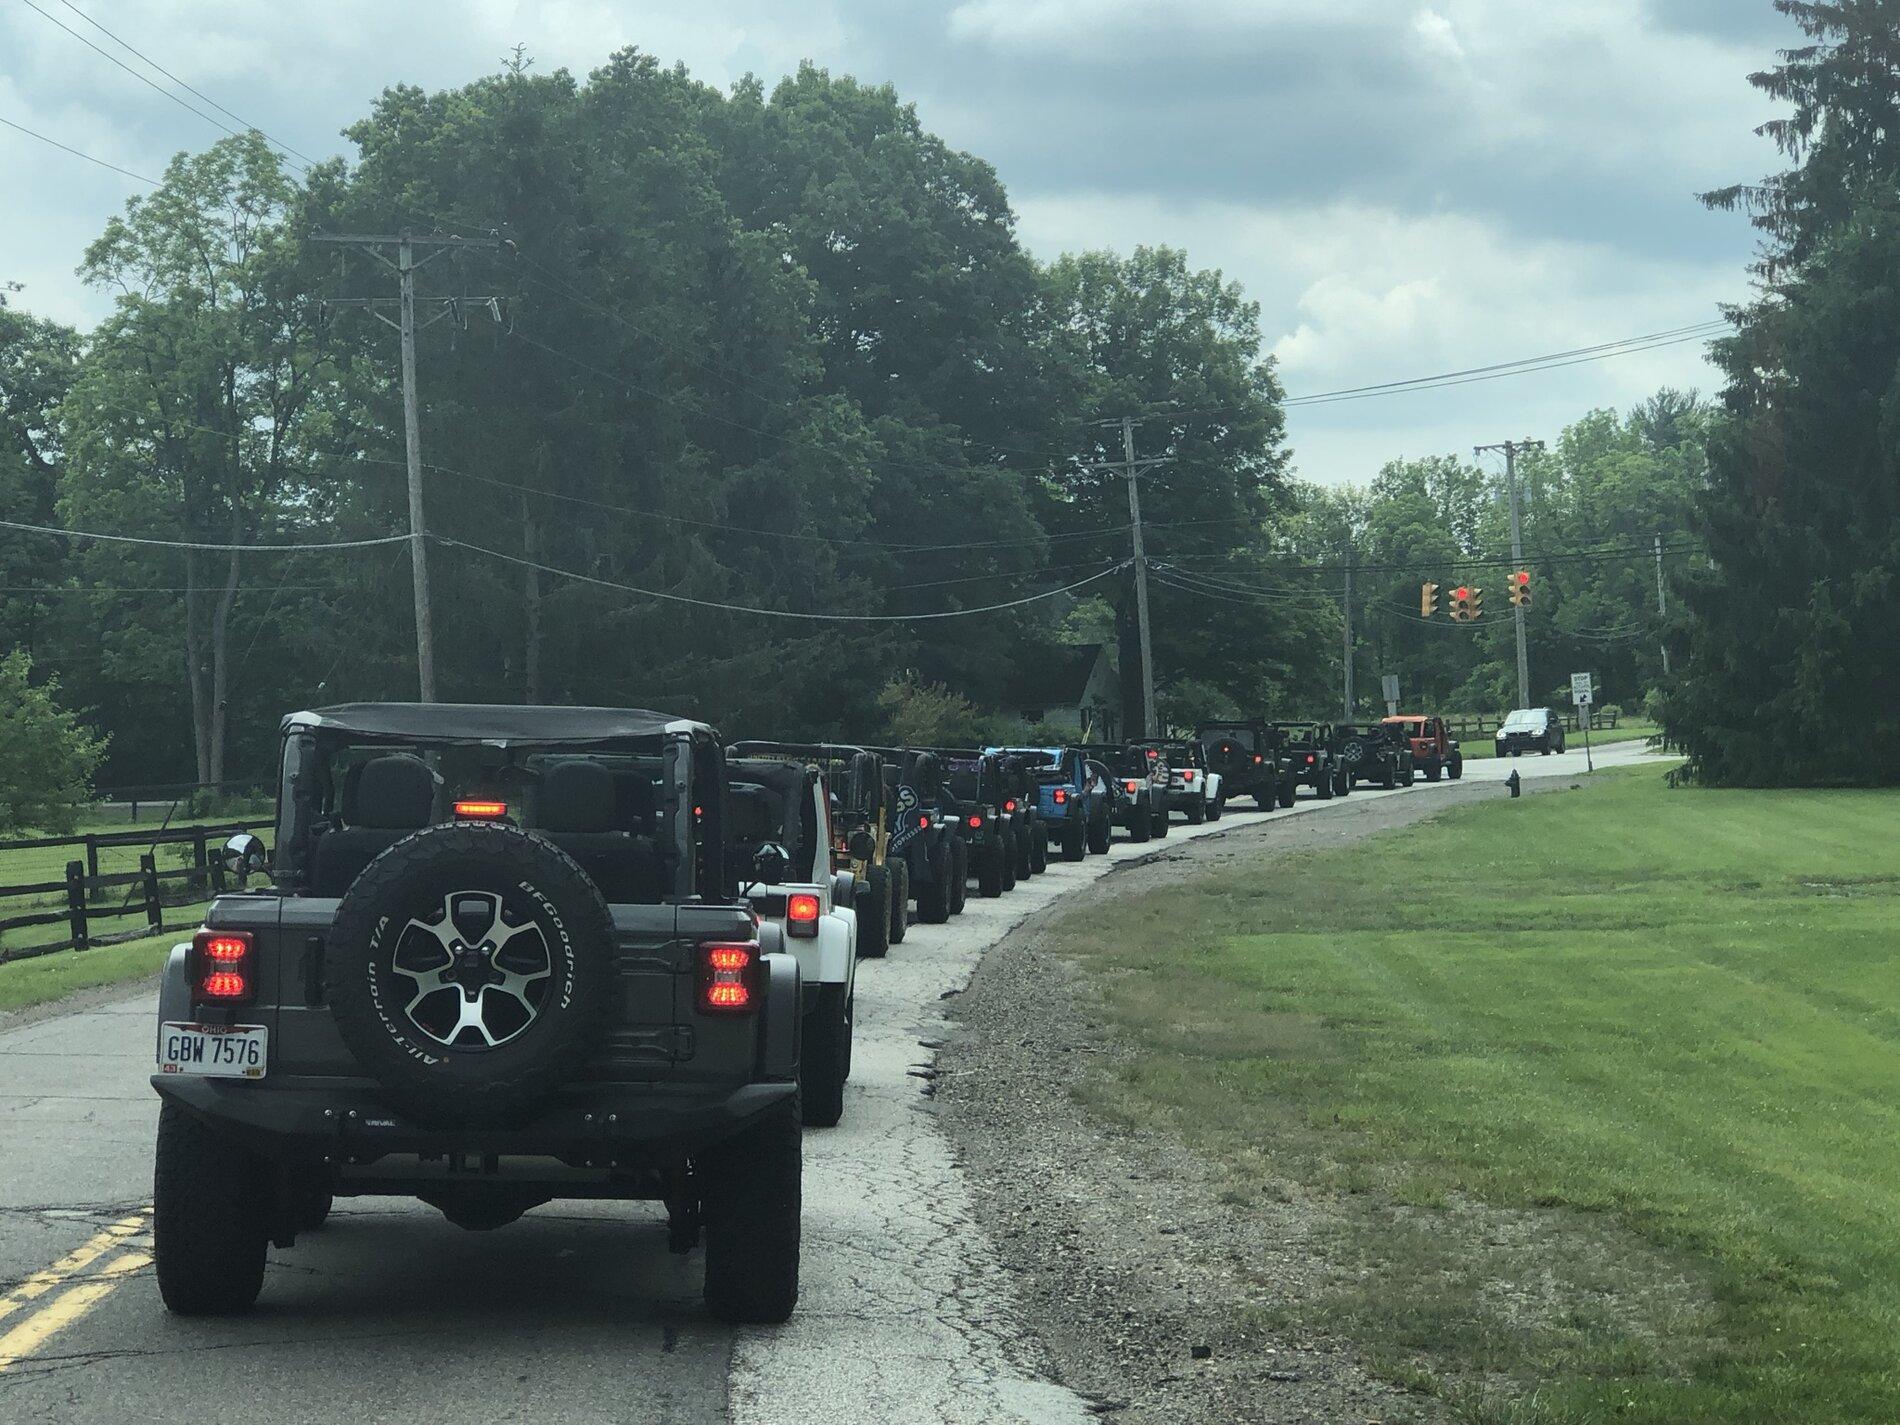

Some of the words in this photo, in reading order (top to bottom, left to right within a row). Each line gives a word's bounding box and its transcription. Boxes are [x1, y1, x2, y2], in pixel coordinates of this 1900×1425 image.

[369, 915, 390, 950] T/A
[202, 1025, 228, 1034] OHIO
[168, 1035, 205, 1063] GBW
[211, 1037, 260, 1065] 7576
